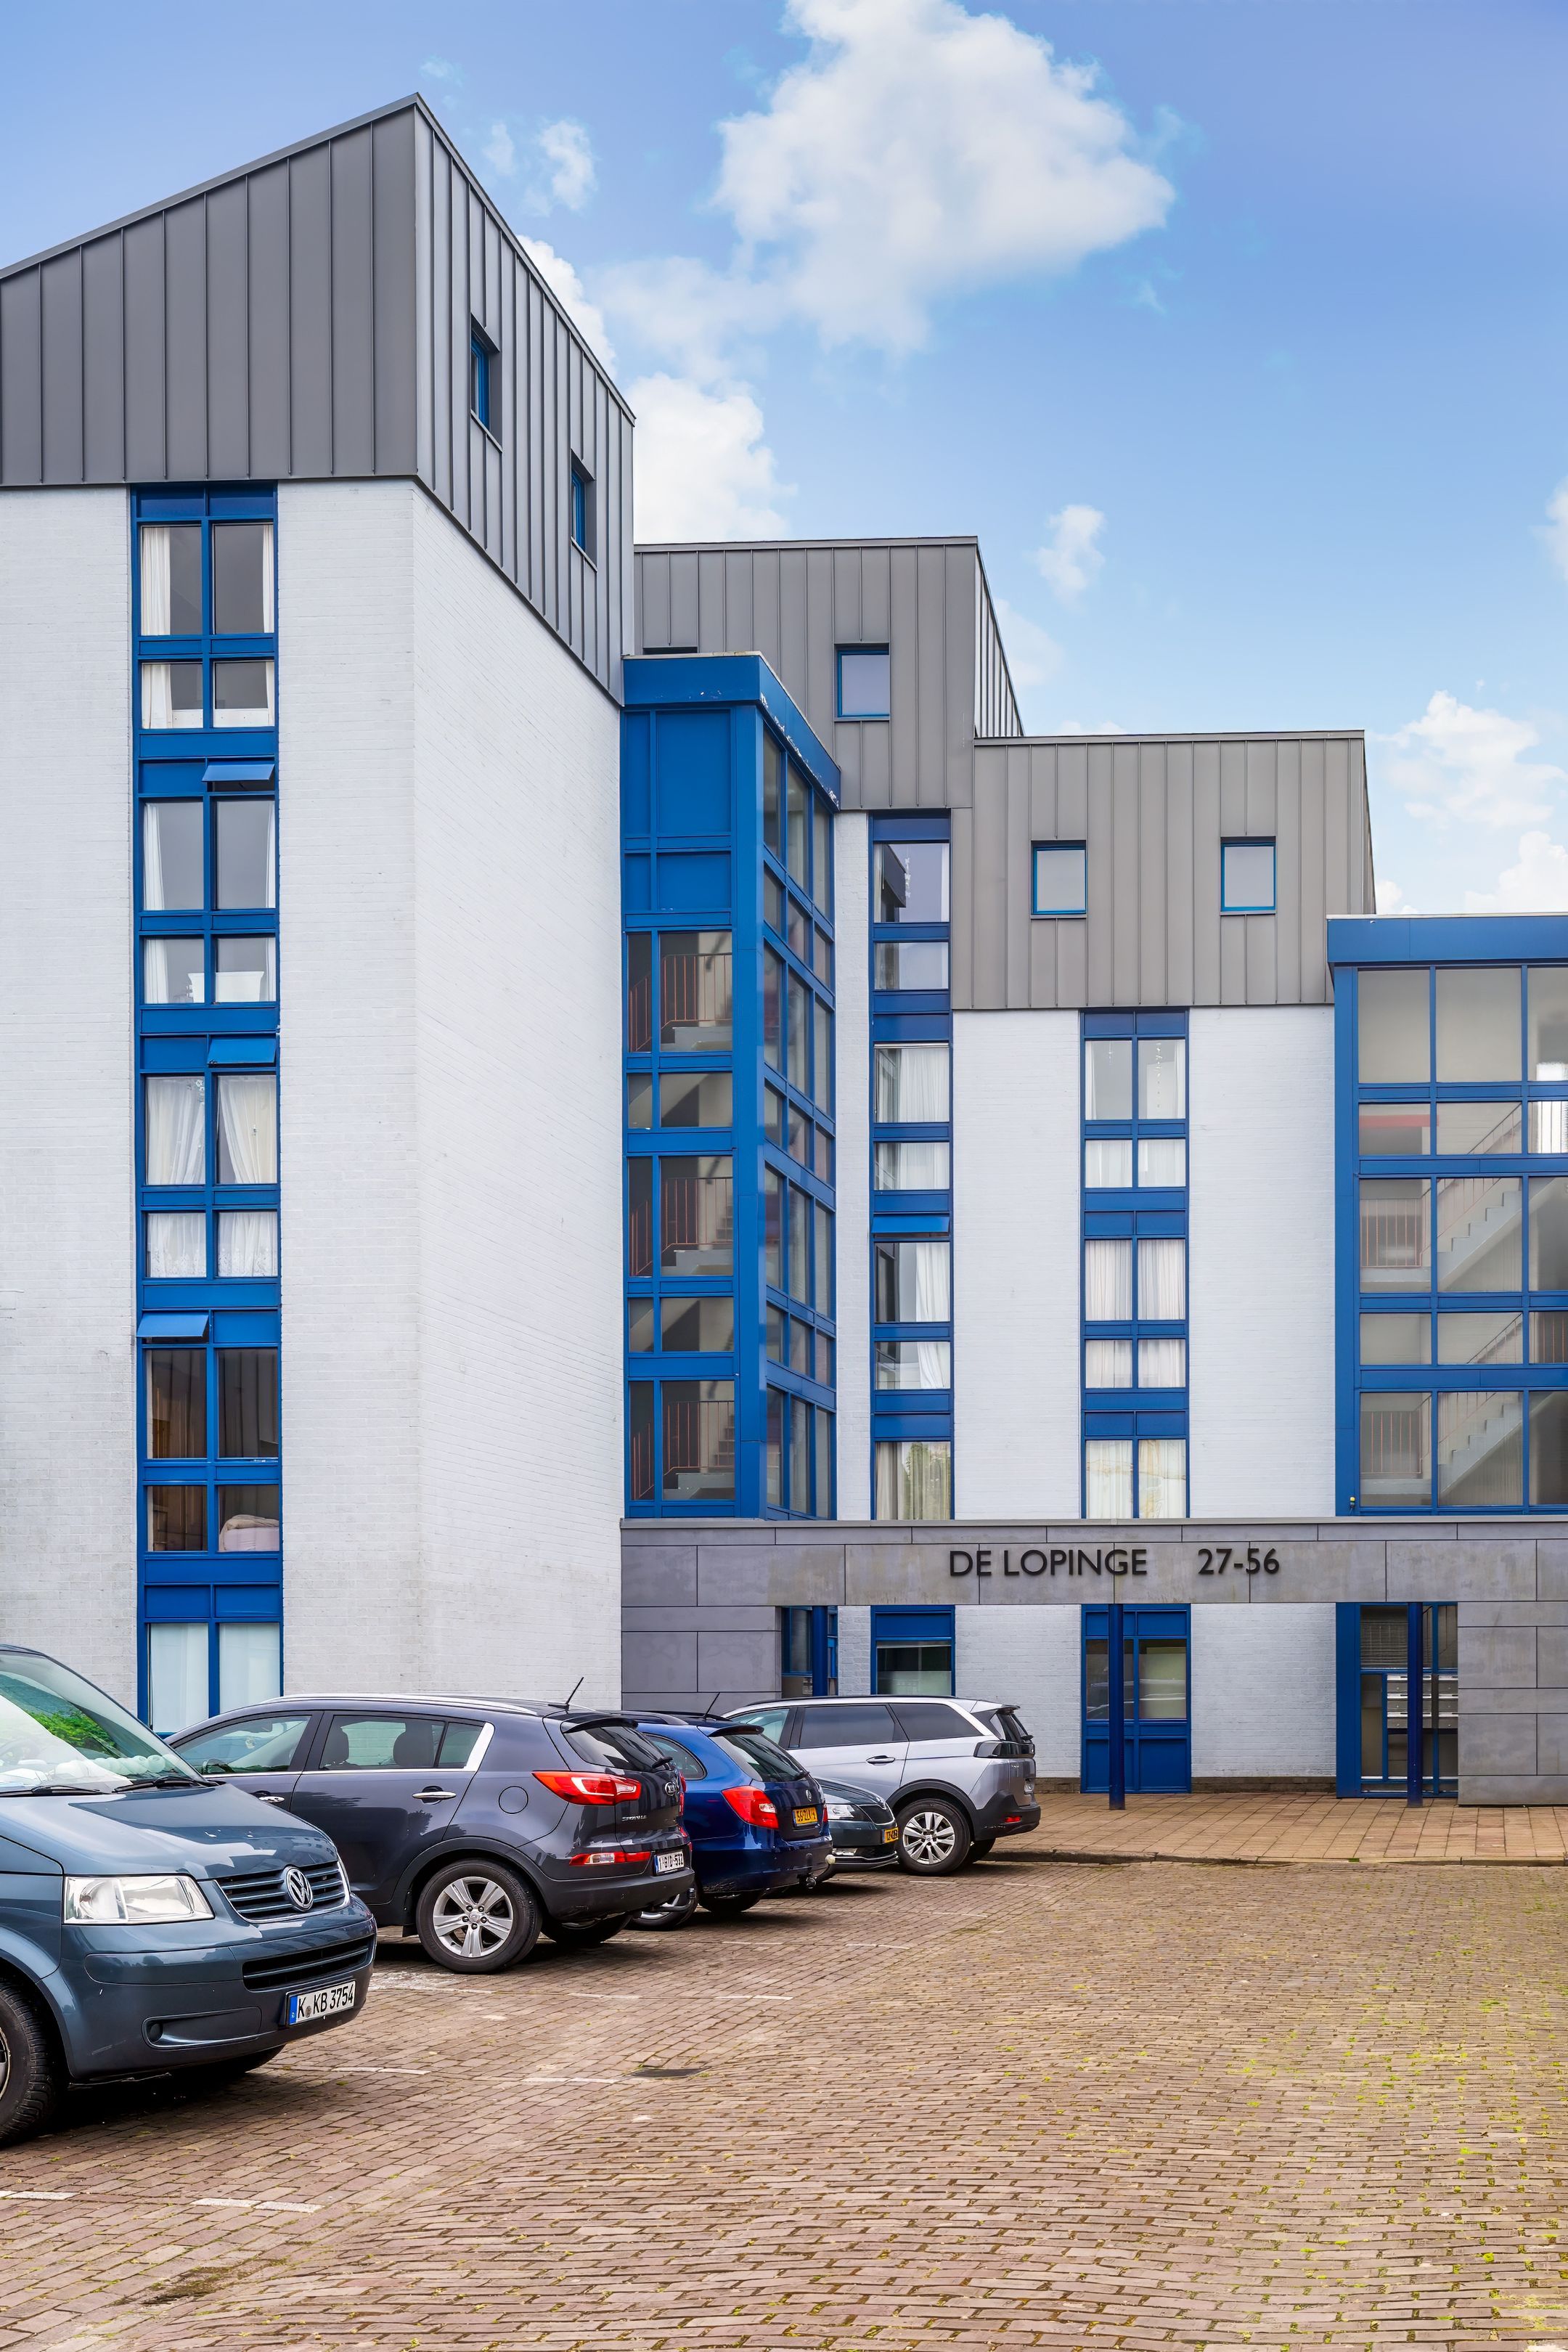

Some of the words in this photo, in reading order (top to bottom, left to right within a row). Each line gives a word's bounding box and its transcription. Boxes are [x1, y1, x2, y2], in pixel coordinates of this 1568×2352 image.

[950, 1550, 992, 1577] DE
[1004, 1548, 1147, 1576] LOPINGE
[1197, 1548, 1280, 1575] 27-56
[298, 1997, 306, 2018] K
[313, 1992, 327, 2014] KB
[330, 1984, 354, 2009] 3754
